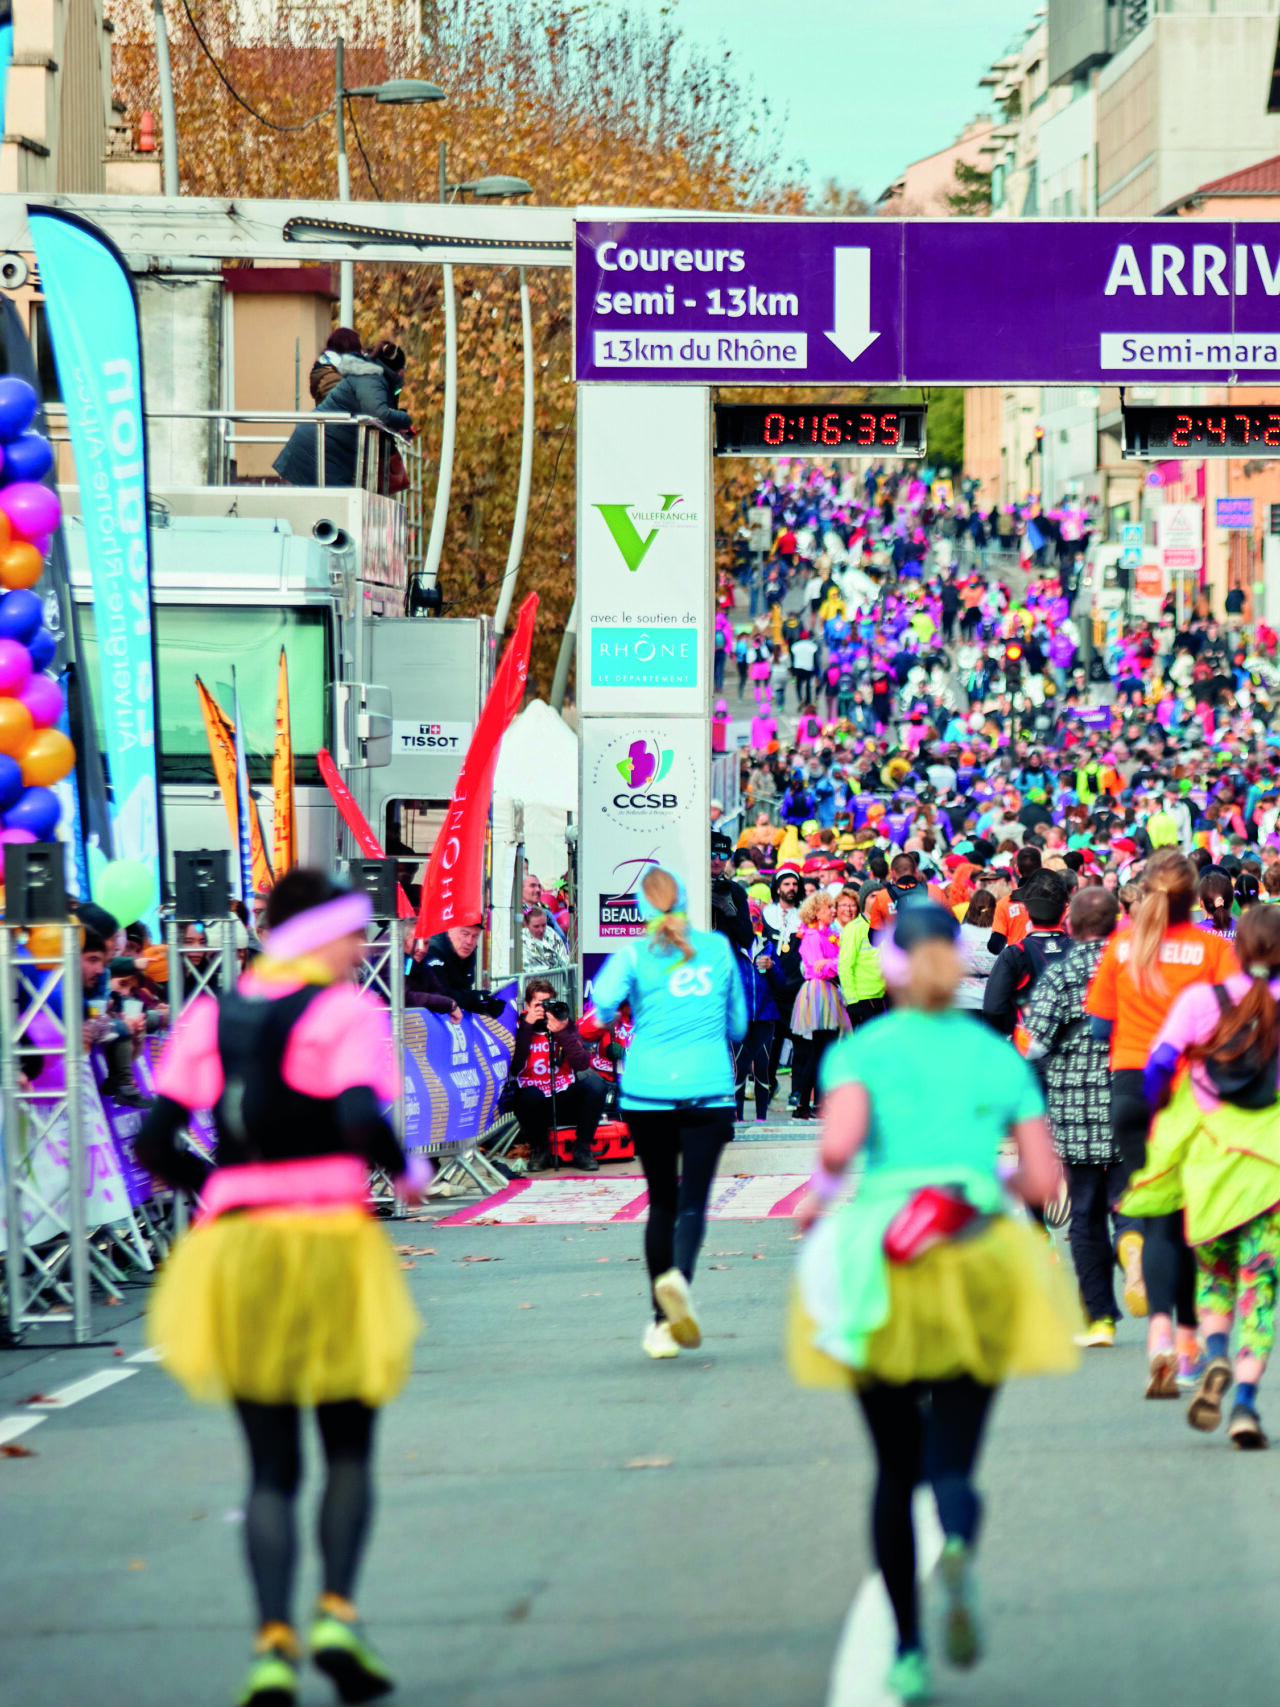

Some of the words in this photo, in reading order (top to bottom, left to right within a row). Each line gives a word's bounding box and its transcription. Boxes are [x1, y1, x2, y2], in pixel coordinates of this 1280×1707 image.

[595, 241, 746, 272] Coureurs
[595, 285, 675, 316] semi
[707, 286, 799, 318] 13km
[602, 337, 674, 363] 13km
[679, 337, 711, 362] du
[716, 334, 798, 363] Rhône
[764, 413, 899, 446] 0:16:35
[632, 511, 698, 521] VILLEFRANCHE
[590, 614, 618, 623] avec
[622, 611, 633, 623] le
[637, 612, 677, 624] soutien
[682, 612, 697, 624] de
[600, 633, 689, 662] RHÔNE
[615, 673, 689, 683] DÉPARTEMENT
[401, 736, 459, 747] TISSOT
[613, 794, 678, 809] CCSB
[602, 927, 626, 936] INTER
